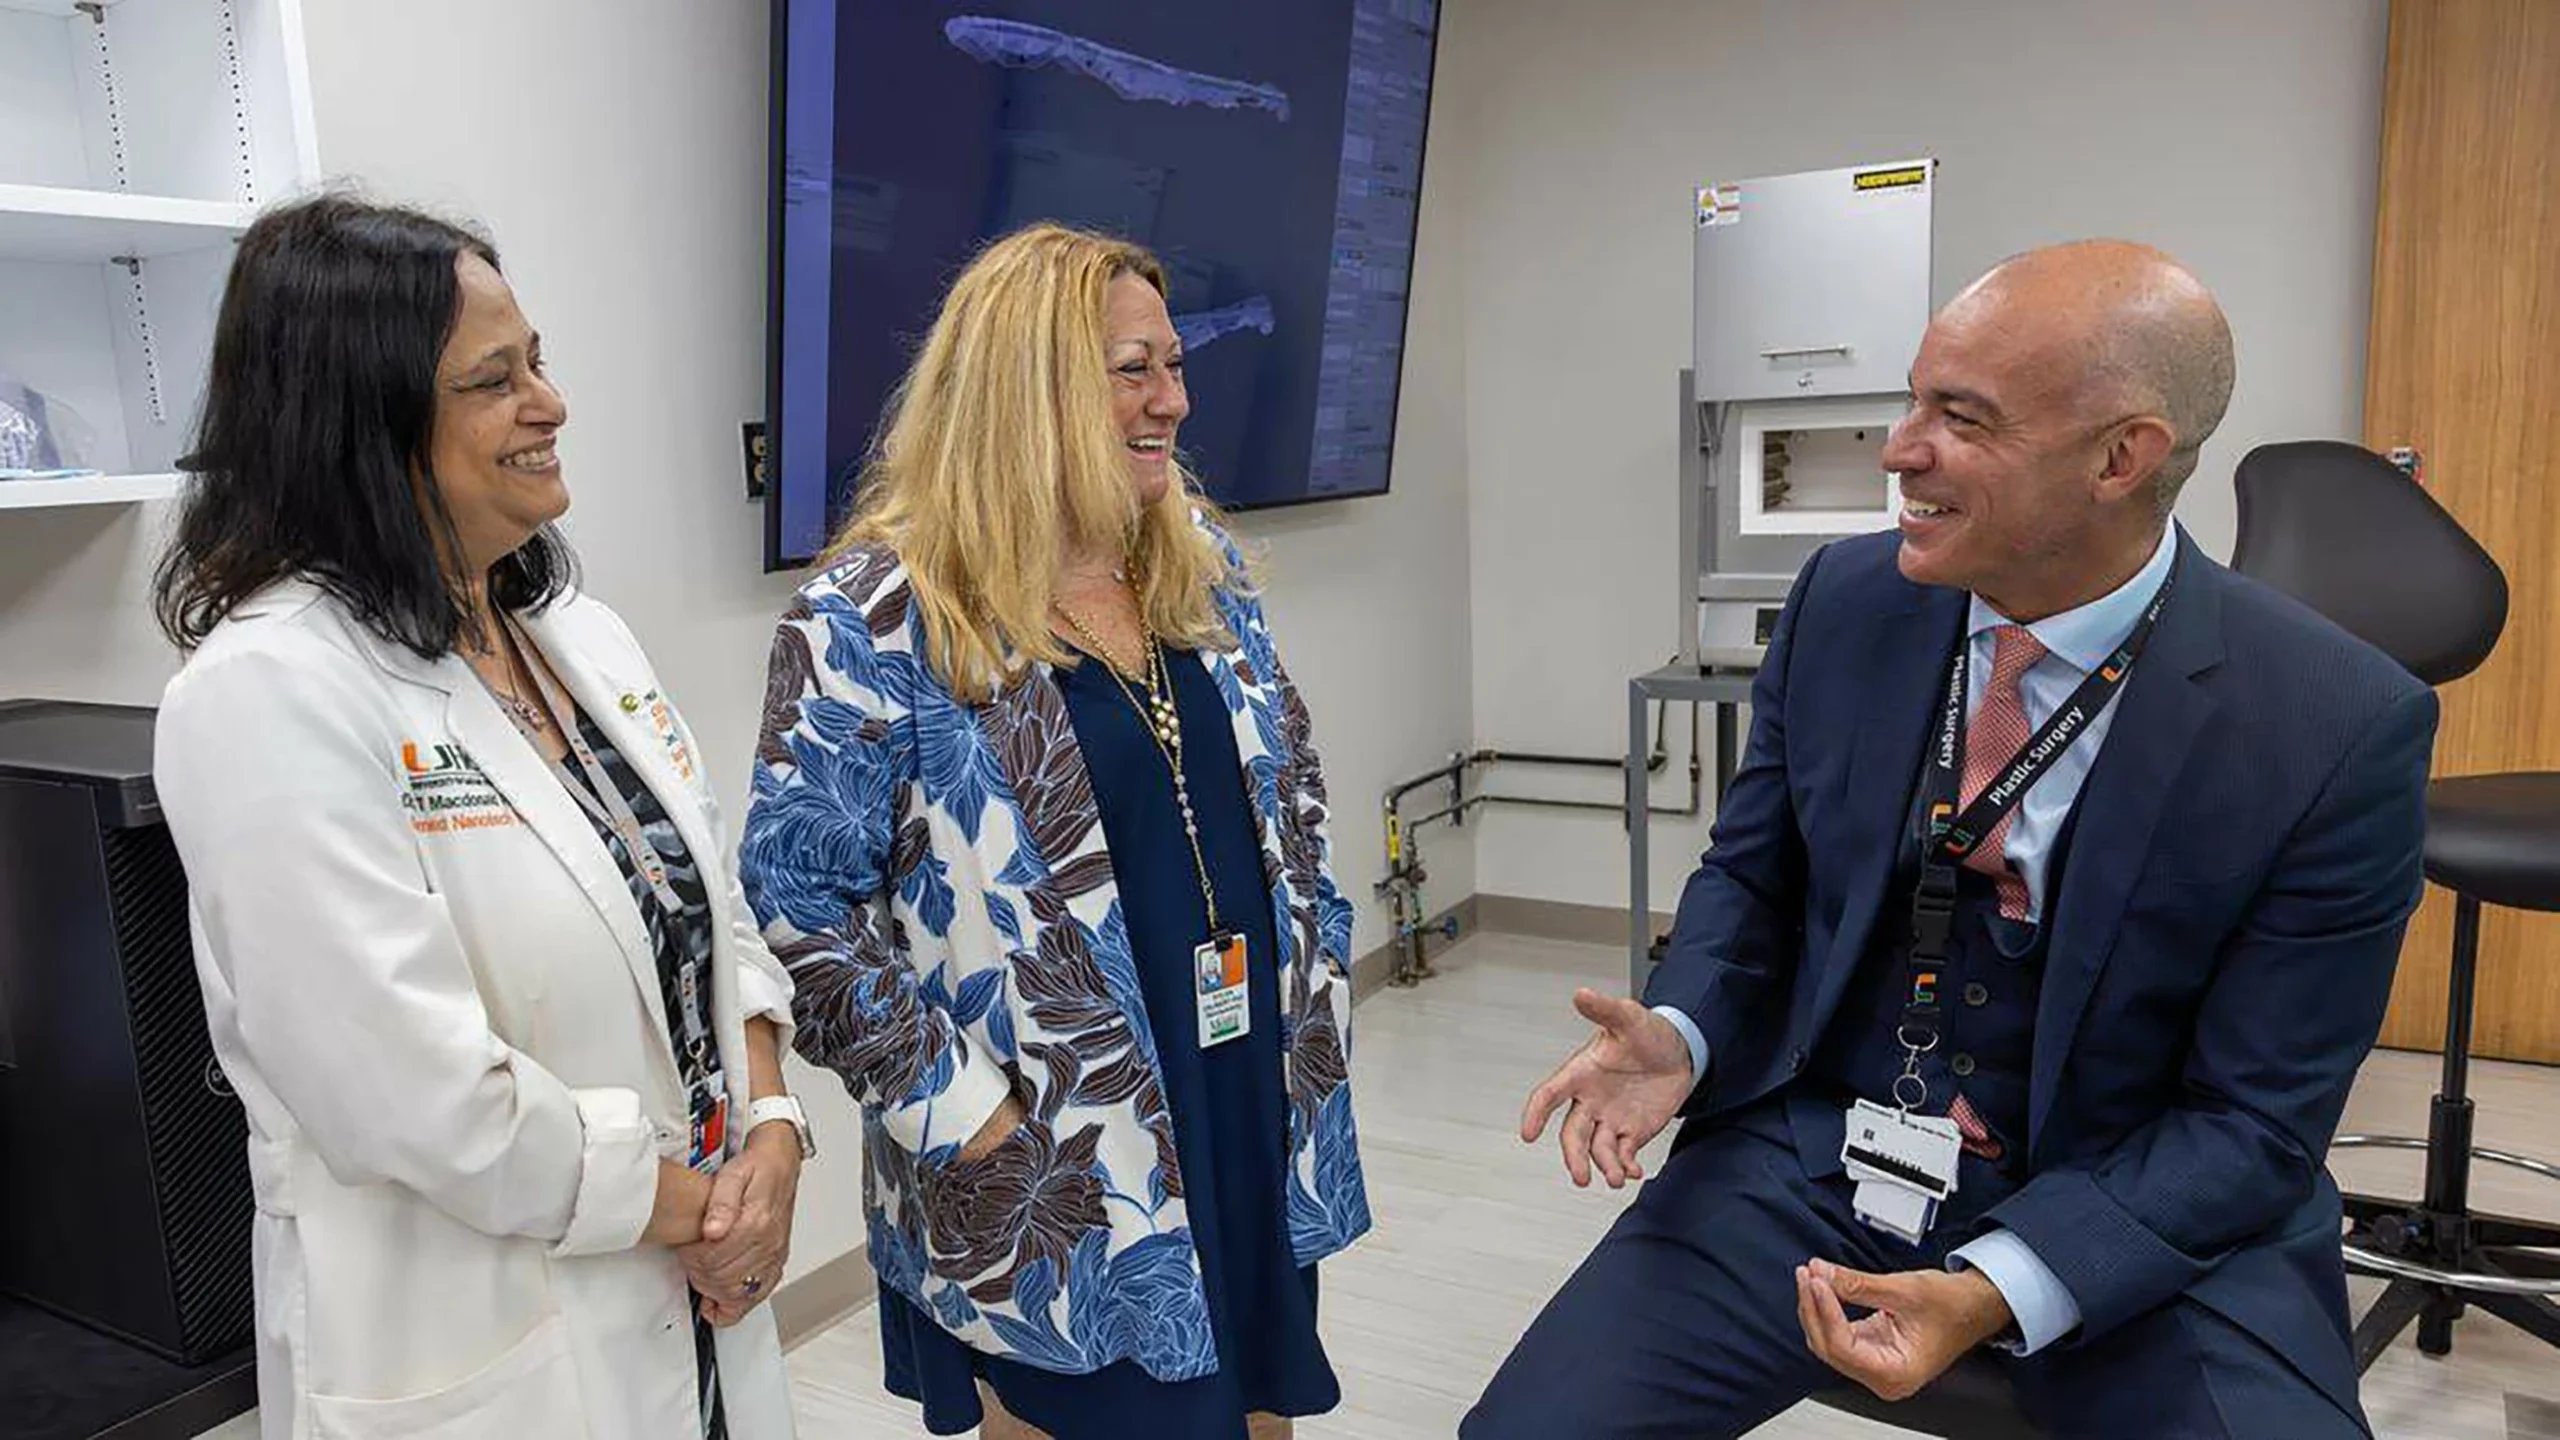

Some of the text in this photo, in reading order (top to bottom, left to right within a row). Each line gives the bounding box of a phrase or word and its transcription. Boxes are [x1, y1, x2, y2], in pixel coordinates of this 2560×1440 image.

[1938, 706, 1959, 769] Surgery
[1988, 706, 2084, 806] Plastic Surgery
